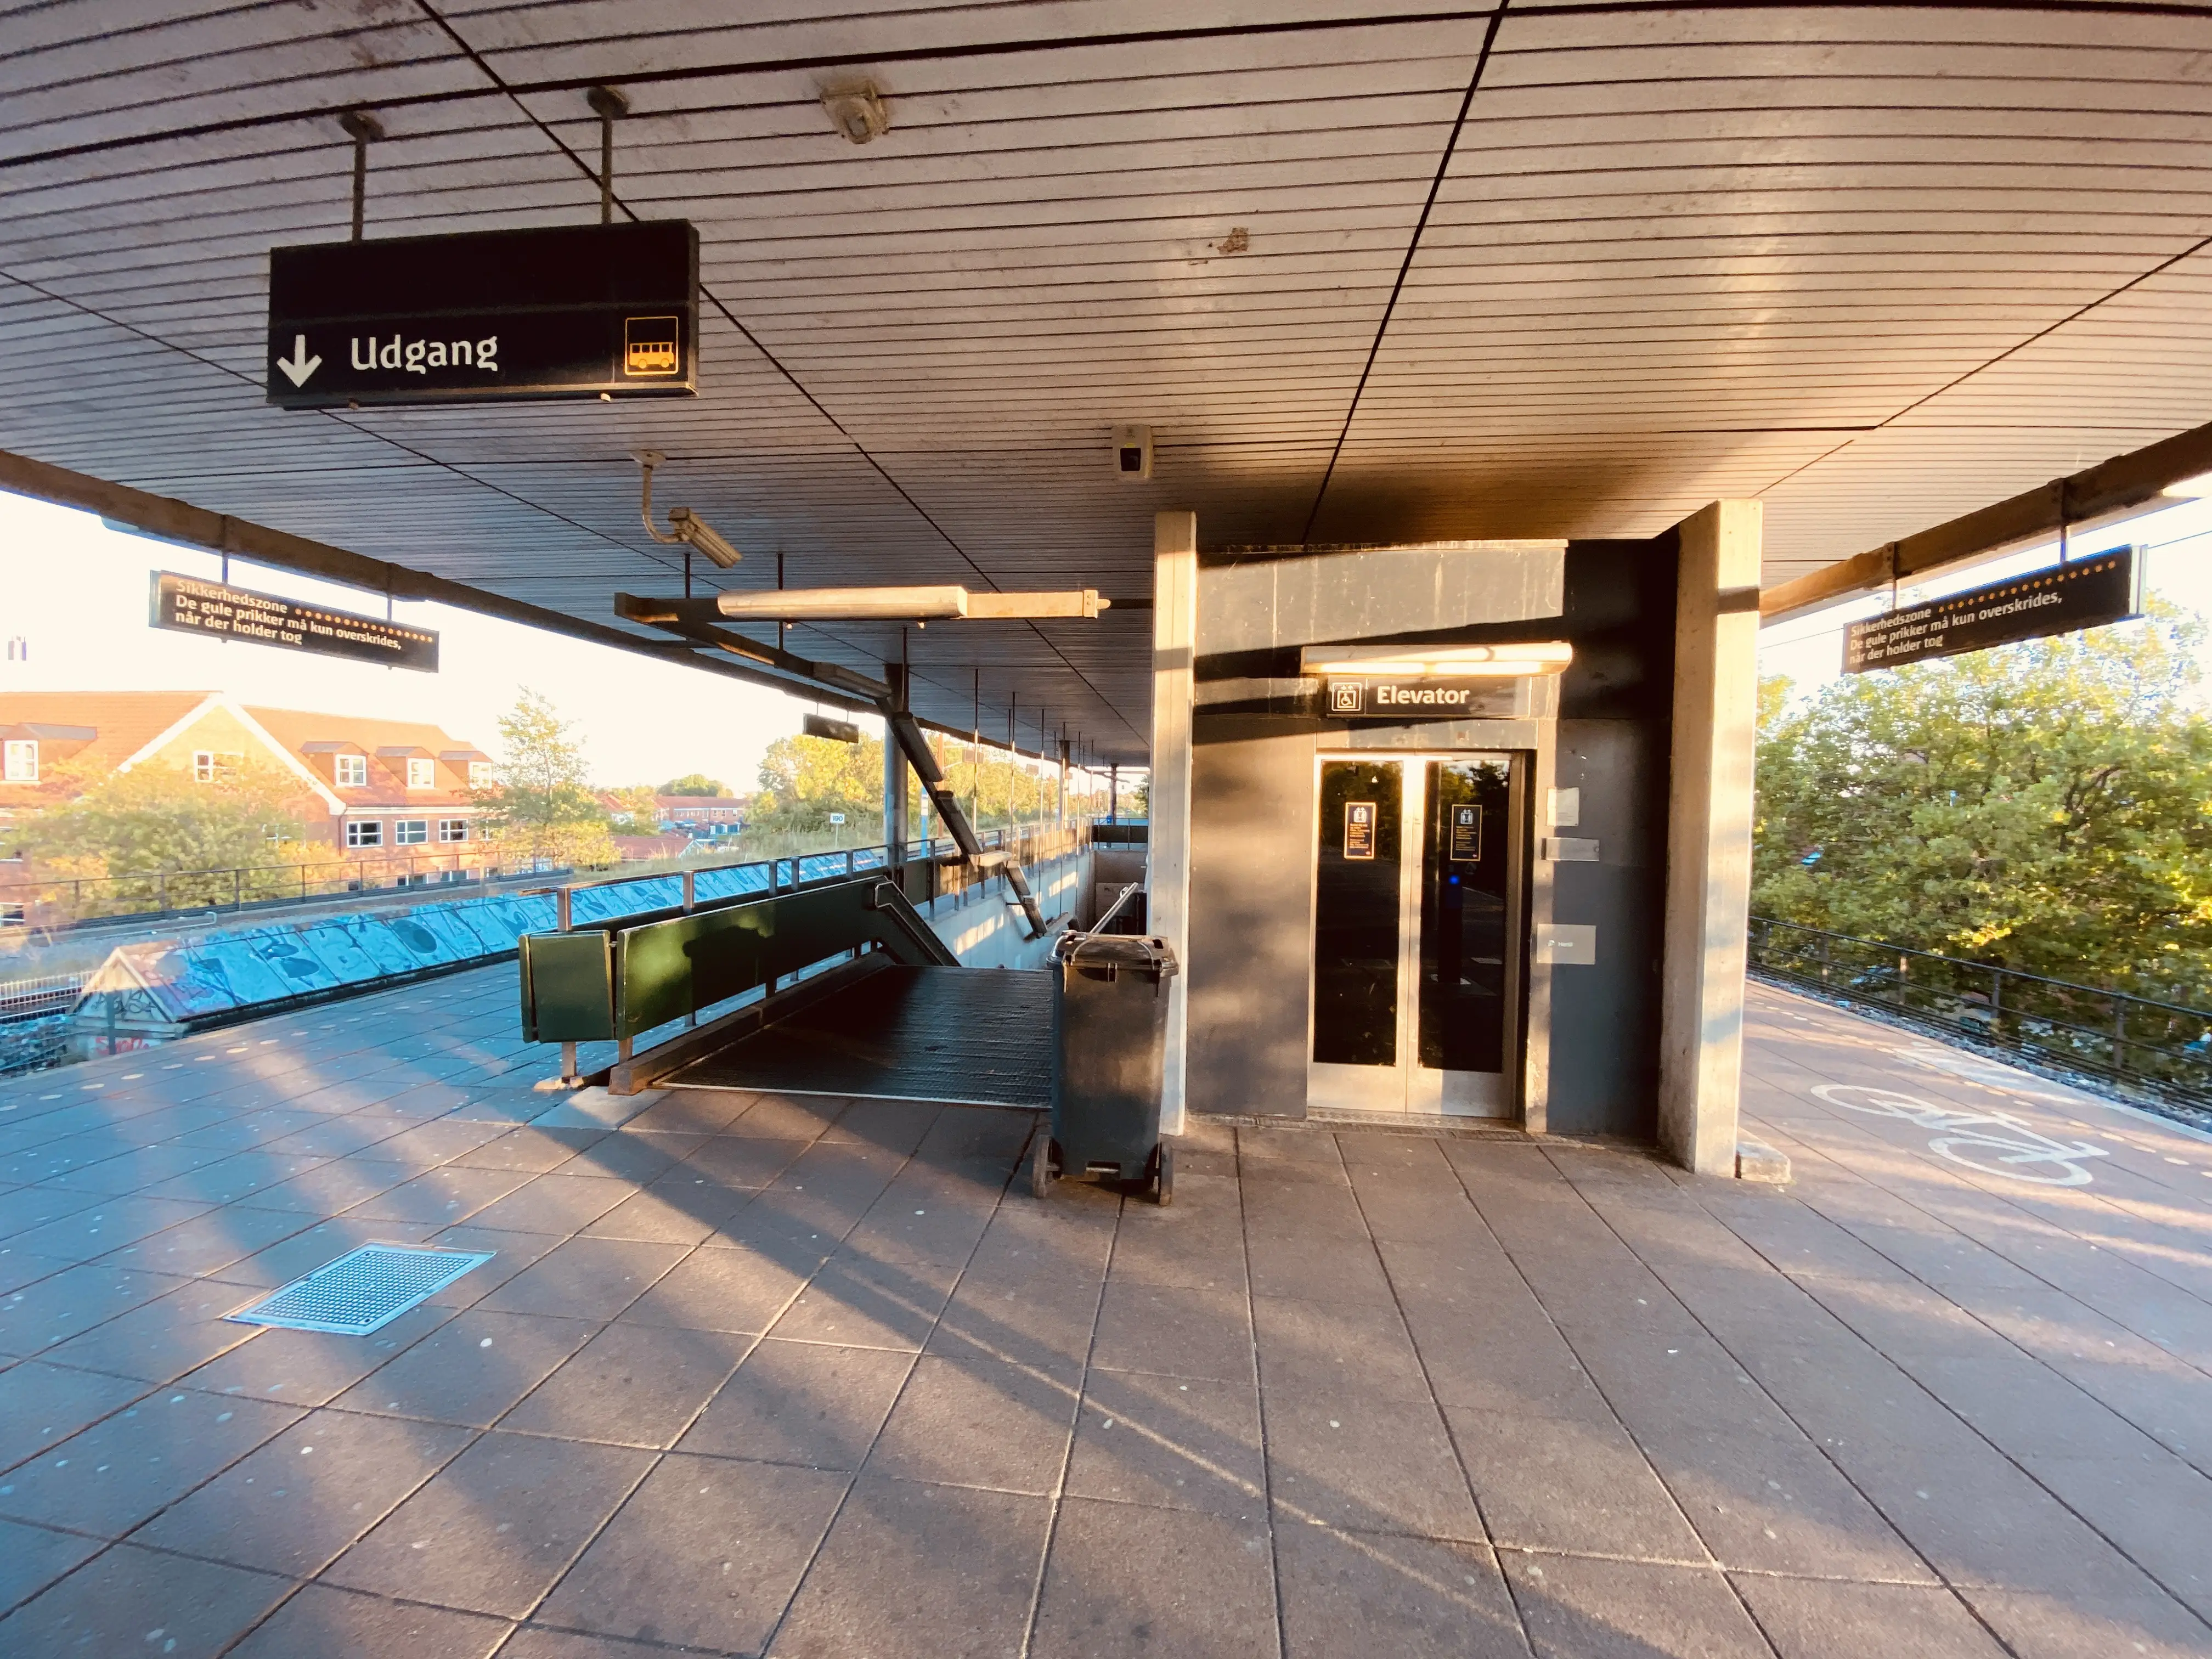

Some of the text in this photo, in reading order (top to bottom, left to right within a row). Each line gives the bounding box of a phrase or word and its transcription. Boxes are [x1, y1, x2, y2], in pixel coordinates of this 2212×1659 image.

[350, 334, 498, 375] Udgang
[176, 580, 288, 613] Sikkerhedszone
[175, 611, 302, 645] når der holder tog
[176, 594, 402, 650] De gule prikker må kun overskrides,
[1850, 592, 2063, 651] De gule prikker må kun overskrides,
[1851, 608, 1932, 637] Sikkerhedszone
[1849, 634, 1943, 665] når der holder tog
[1377, 685, 1470, 704] Elevator
